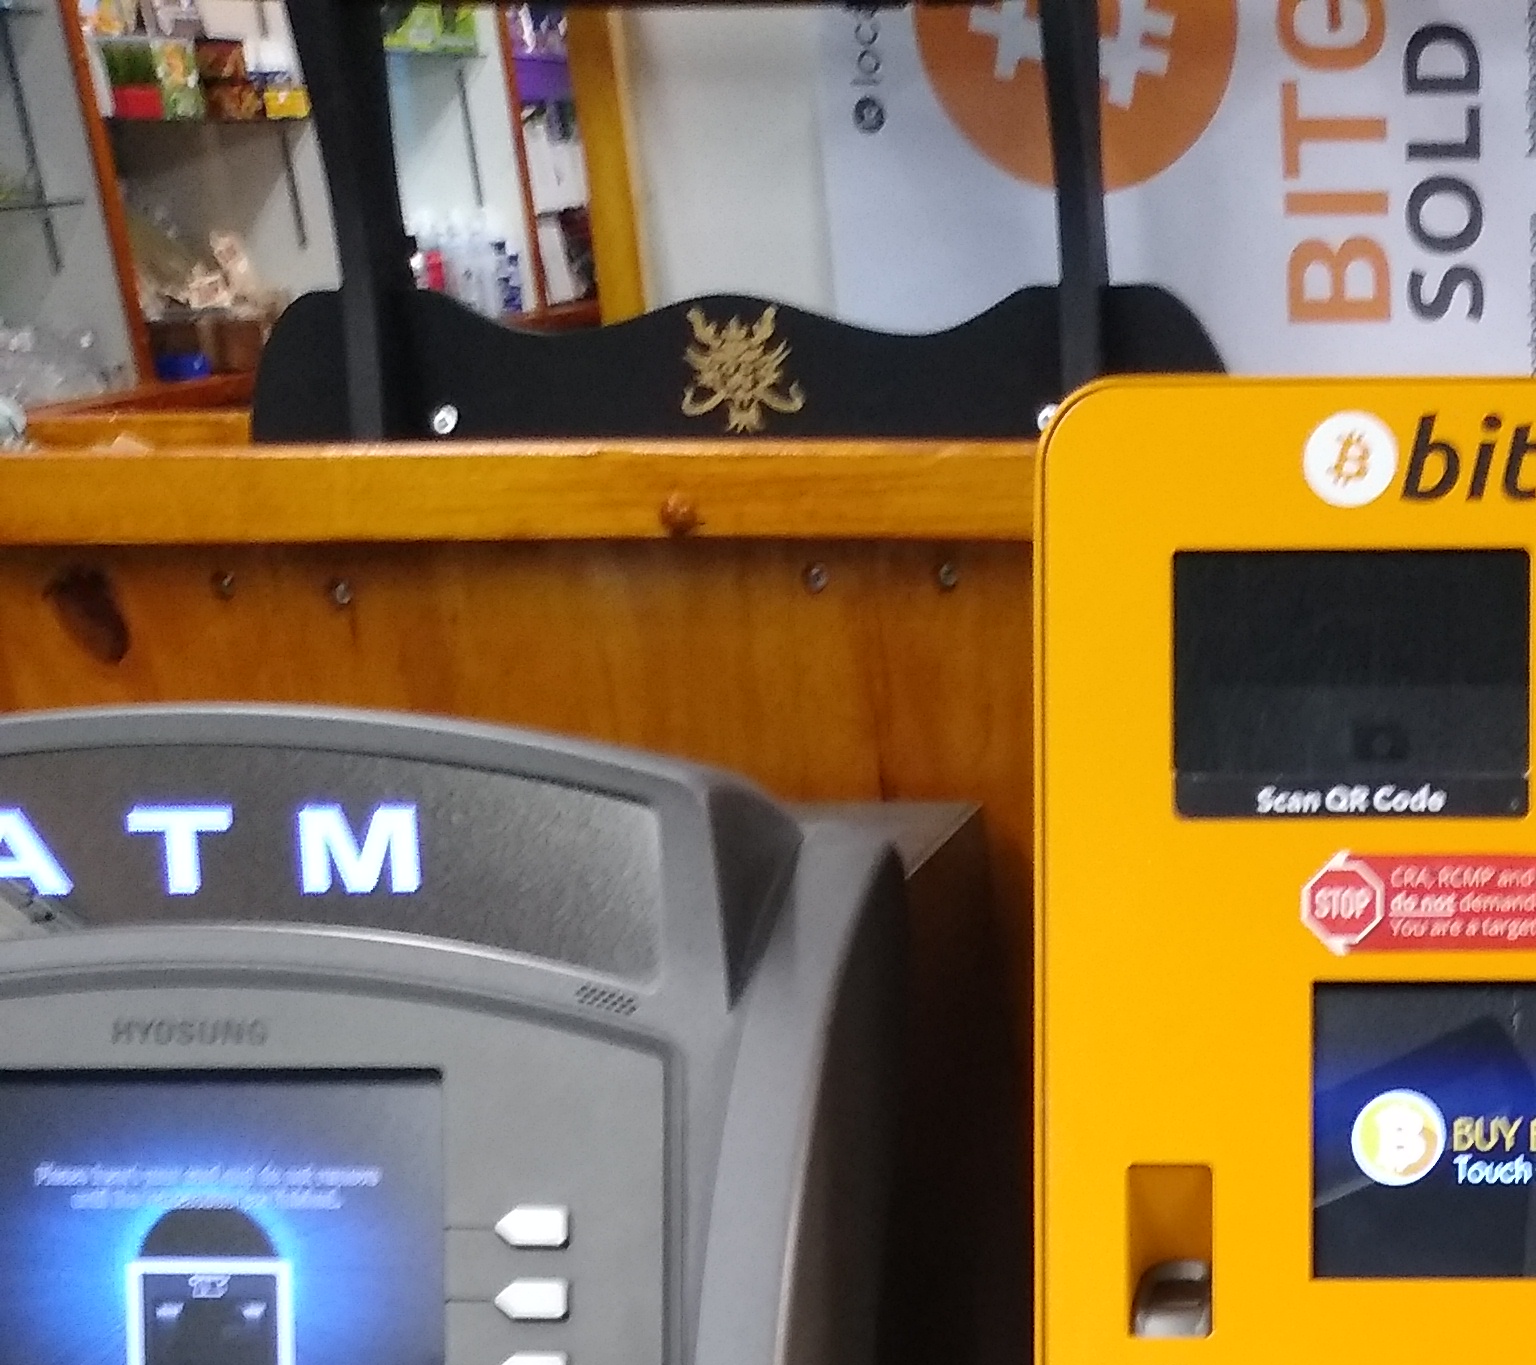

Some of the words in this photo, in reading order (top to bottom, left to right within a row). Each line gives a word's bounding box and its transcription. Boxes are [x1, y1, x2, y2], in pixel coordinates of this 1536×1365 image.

[1403, 23, 1485, 322] SOLD
[1256, 784, 1323, 814] Scan
[1325, 783, 1371, 814] QR
[1373, 783, 1448, 813] Code
[0, 802, 424, 897] ATM
[1497, 866, 1534, 889] and
[1313, 886, 1372, 921] STOP
[1390, 892, 1417, 912] do
[1419, 892, 1455, 912] not
[1390, 917, 1426, 938] You
[1429, 919, 1463, 938] are
[1466, 920, 1478, 937] a
[109, 1016, 270, 1047] HYOSUNG
[1452, 1115, 1522, 1154] BUY
[1453, 1153, 1533, 1186] Touch
